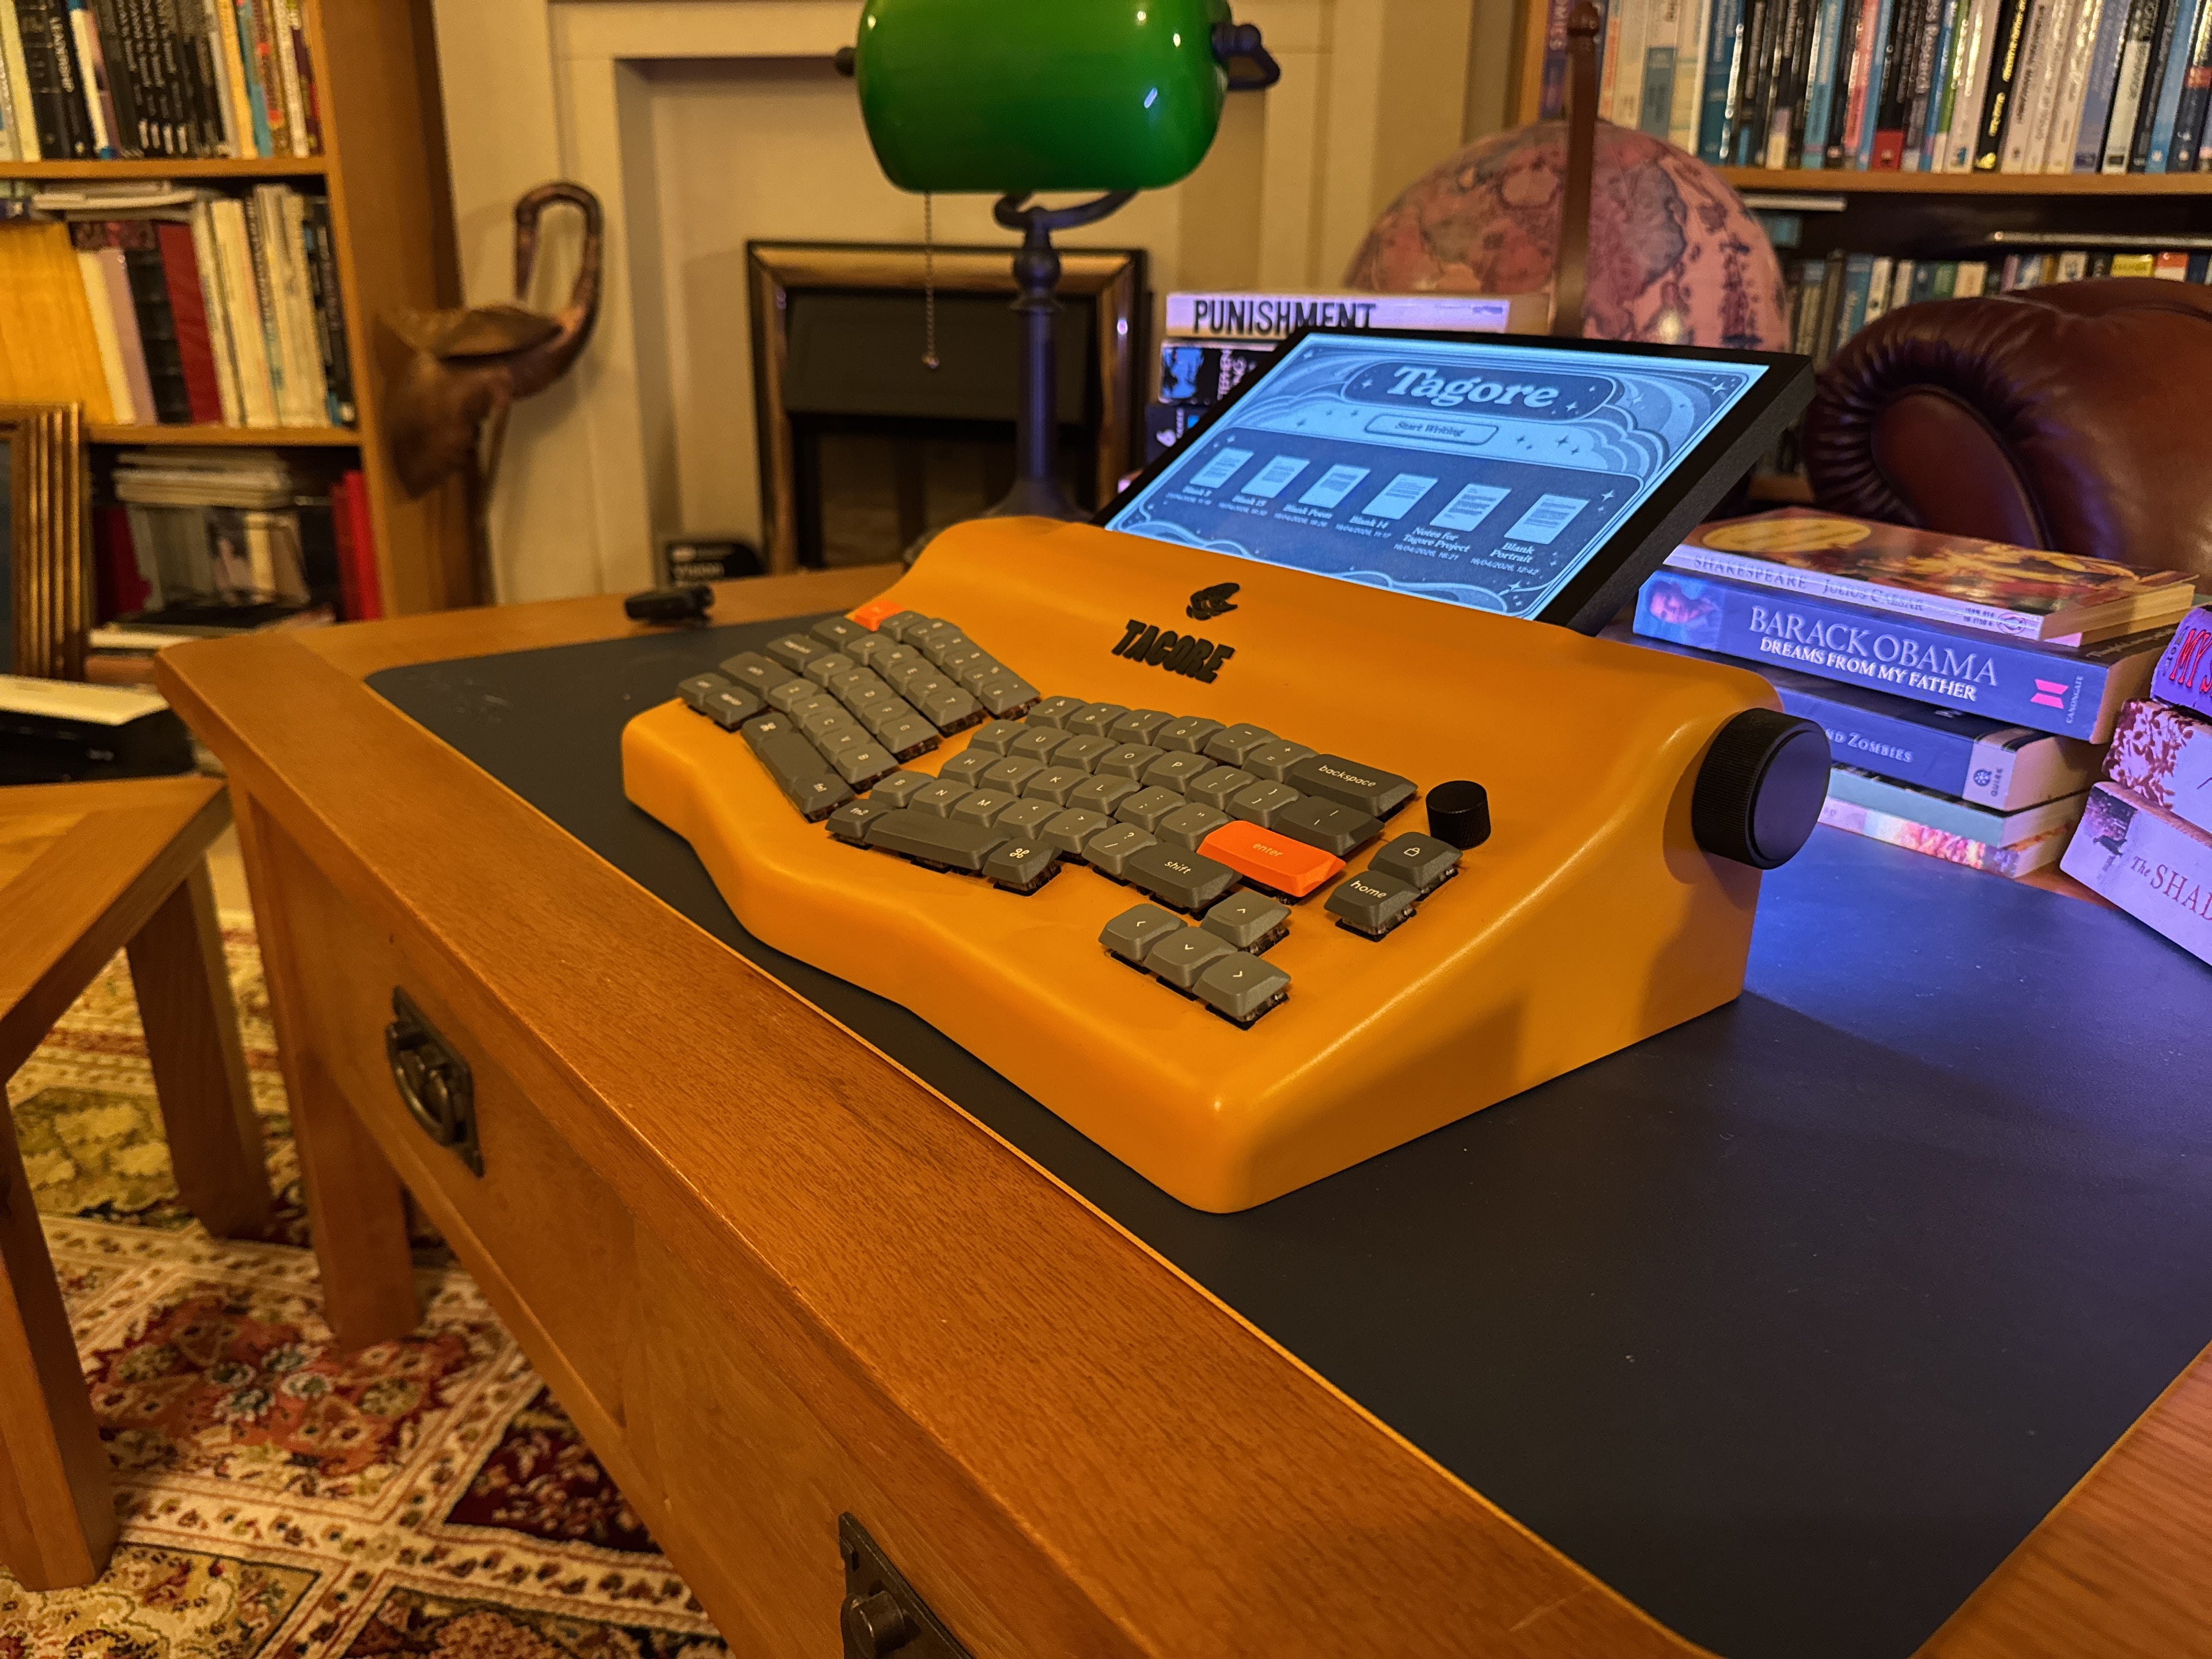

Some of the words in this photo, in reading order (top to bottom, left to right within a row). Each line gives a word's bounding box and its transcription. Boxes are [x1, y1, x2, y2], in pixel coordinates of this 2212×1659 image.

[1193, 298, 1377, 336] PUNISHMENT
[1386, 366, 1560, 407] Tagore
[1395, 421, 1423, 431] Start
[1425, 422, 1466, 437] Writing
[1411, 527, 1442, 540] Notes
[1441, 531, 1460, 542] for
[1433, 539, 1471, 554] Project
[1501, 542, 1536, 555] Blank
[1489, 549, 1533, 563] Portrait
[1111, 619, 1236, 684] TAGORE
[1748, 604, 1872, 657] BARACK
[1873, 633, 1999, 687] OBAMA
[1759, 635, 1827, 665] DREAMS
[1826, 651, 1877, 677] FROM
[1878, 664, 1908, 684] MY
[1908, 671, 1978, 702] FATHER
[1825, 728, 1846, 744] ND
[1318, 764, 1377, 787] backspace
[1252, 843, 1283, 857] enter
[1164, 861, 1191, 874] shift
[2130, 855, 2152, 877] The
[1350, 880, 1387, 898] home
